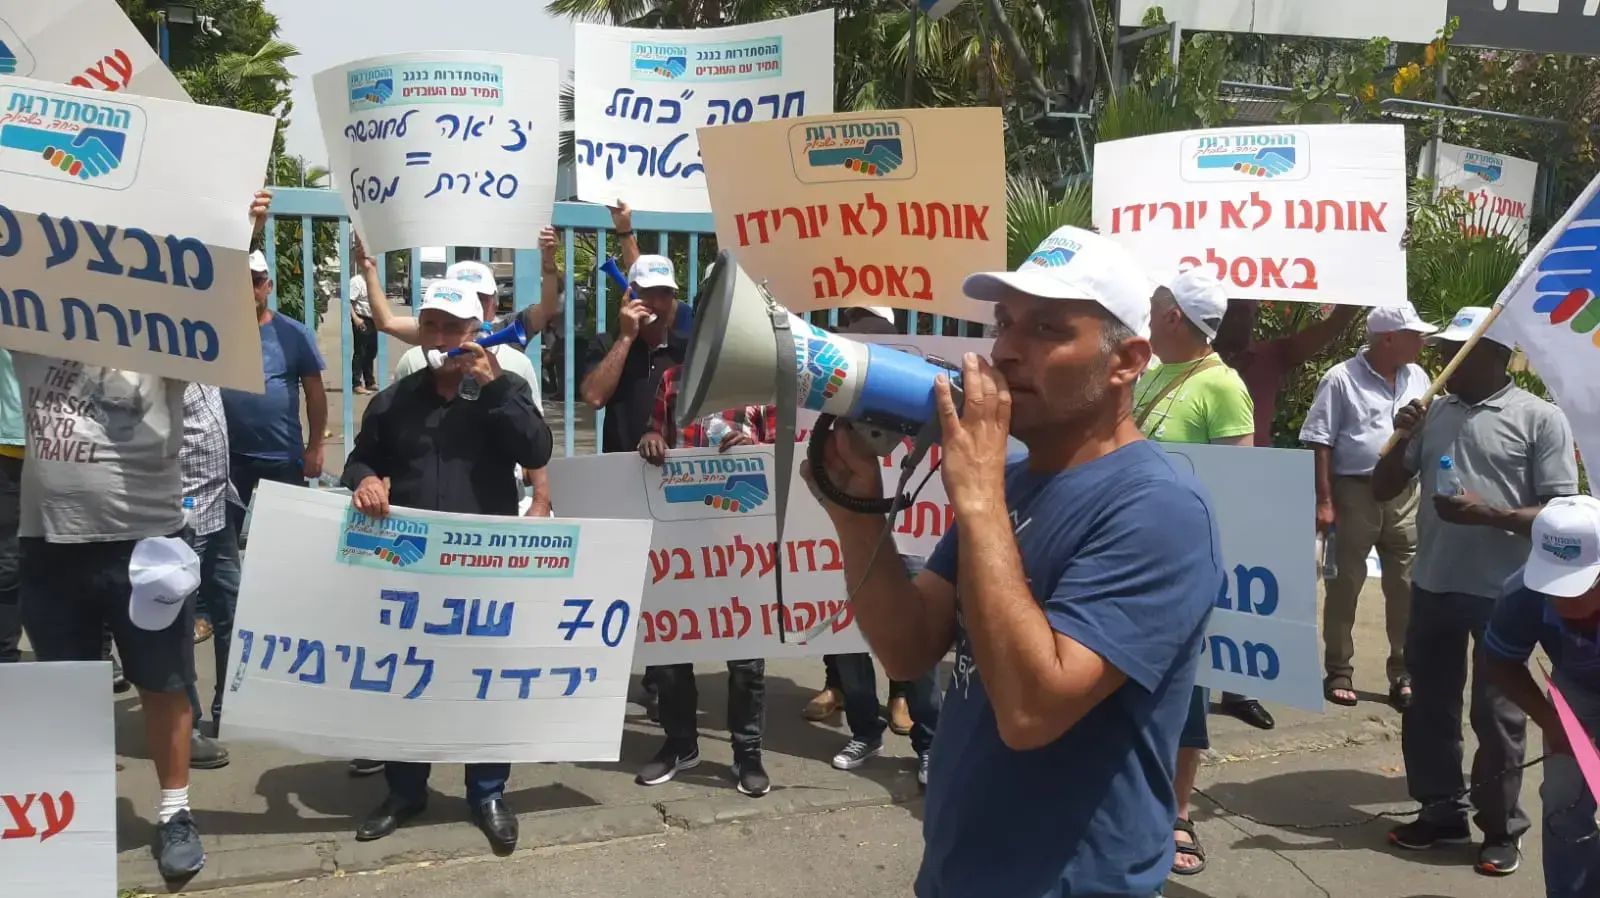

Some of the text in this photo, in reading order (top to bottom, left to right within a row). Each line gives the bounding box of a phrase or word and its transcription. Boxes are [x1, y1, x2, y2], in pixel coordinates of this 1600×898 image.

[63, 48, 132, 92] עצ
[695, 60, 779, 76] תמיד עם העובדים
[696, 44, 779, 61] ההסתדרות בנגב
[402, 86, 499, 99] תמיד עם העובדים
[434, 70, 499, 83] ההסתדרות
[7, 92, 131, 129] ההסתדרות
[706, 90, 805, 126] חרסה
[805, 121, 900, 140] ההסתדרות
[1198, 133, 1296, 149] ההסתדרות
[350, 168, 519, 210] סגירת מפעל
[735, 192, 990, 247] אותנו לא יורידו
[1111, 191, 1388, 234] אותנו לא יורידו
[37, 212, 214, 291] מבצע
[812, 256, 933, 300] באסלה
[61, 297, 220, 362] מחירת
[44, 365, 80, 390] THE
[54, 417, 76, 438] TO
[36, 436, 101, 463] TRAVEL
[661, 457, 765, 476] ההסתדרות
[442, 531, 573, 549] ההסתדרות בנגב
[439, 552, 570, 569] תמיד עם העובדים
[648, 535, 844, 585] בדו עלינו בע
[380, 589, 630, 648] 70 שנה
[641, 608, 702, 643] בפנ
[708, 596, 752, 639] לנו
[229, 629, 598, 700] ירדו לטימיון
